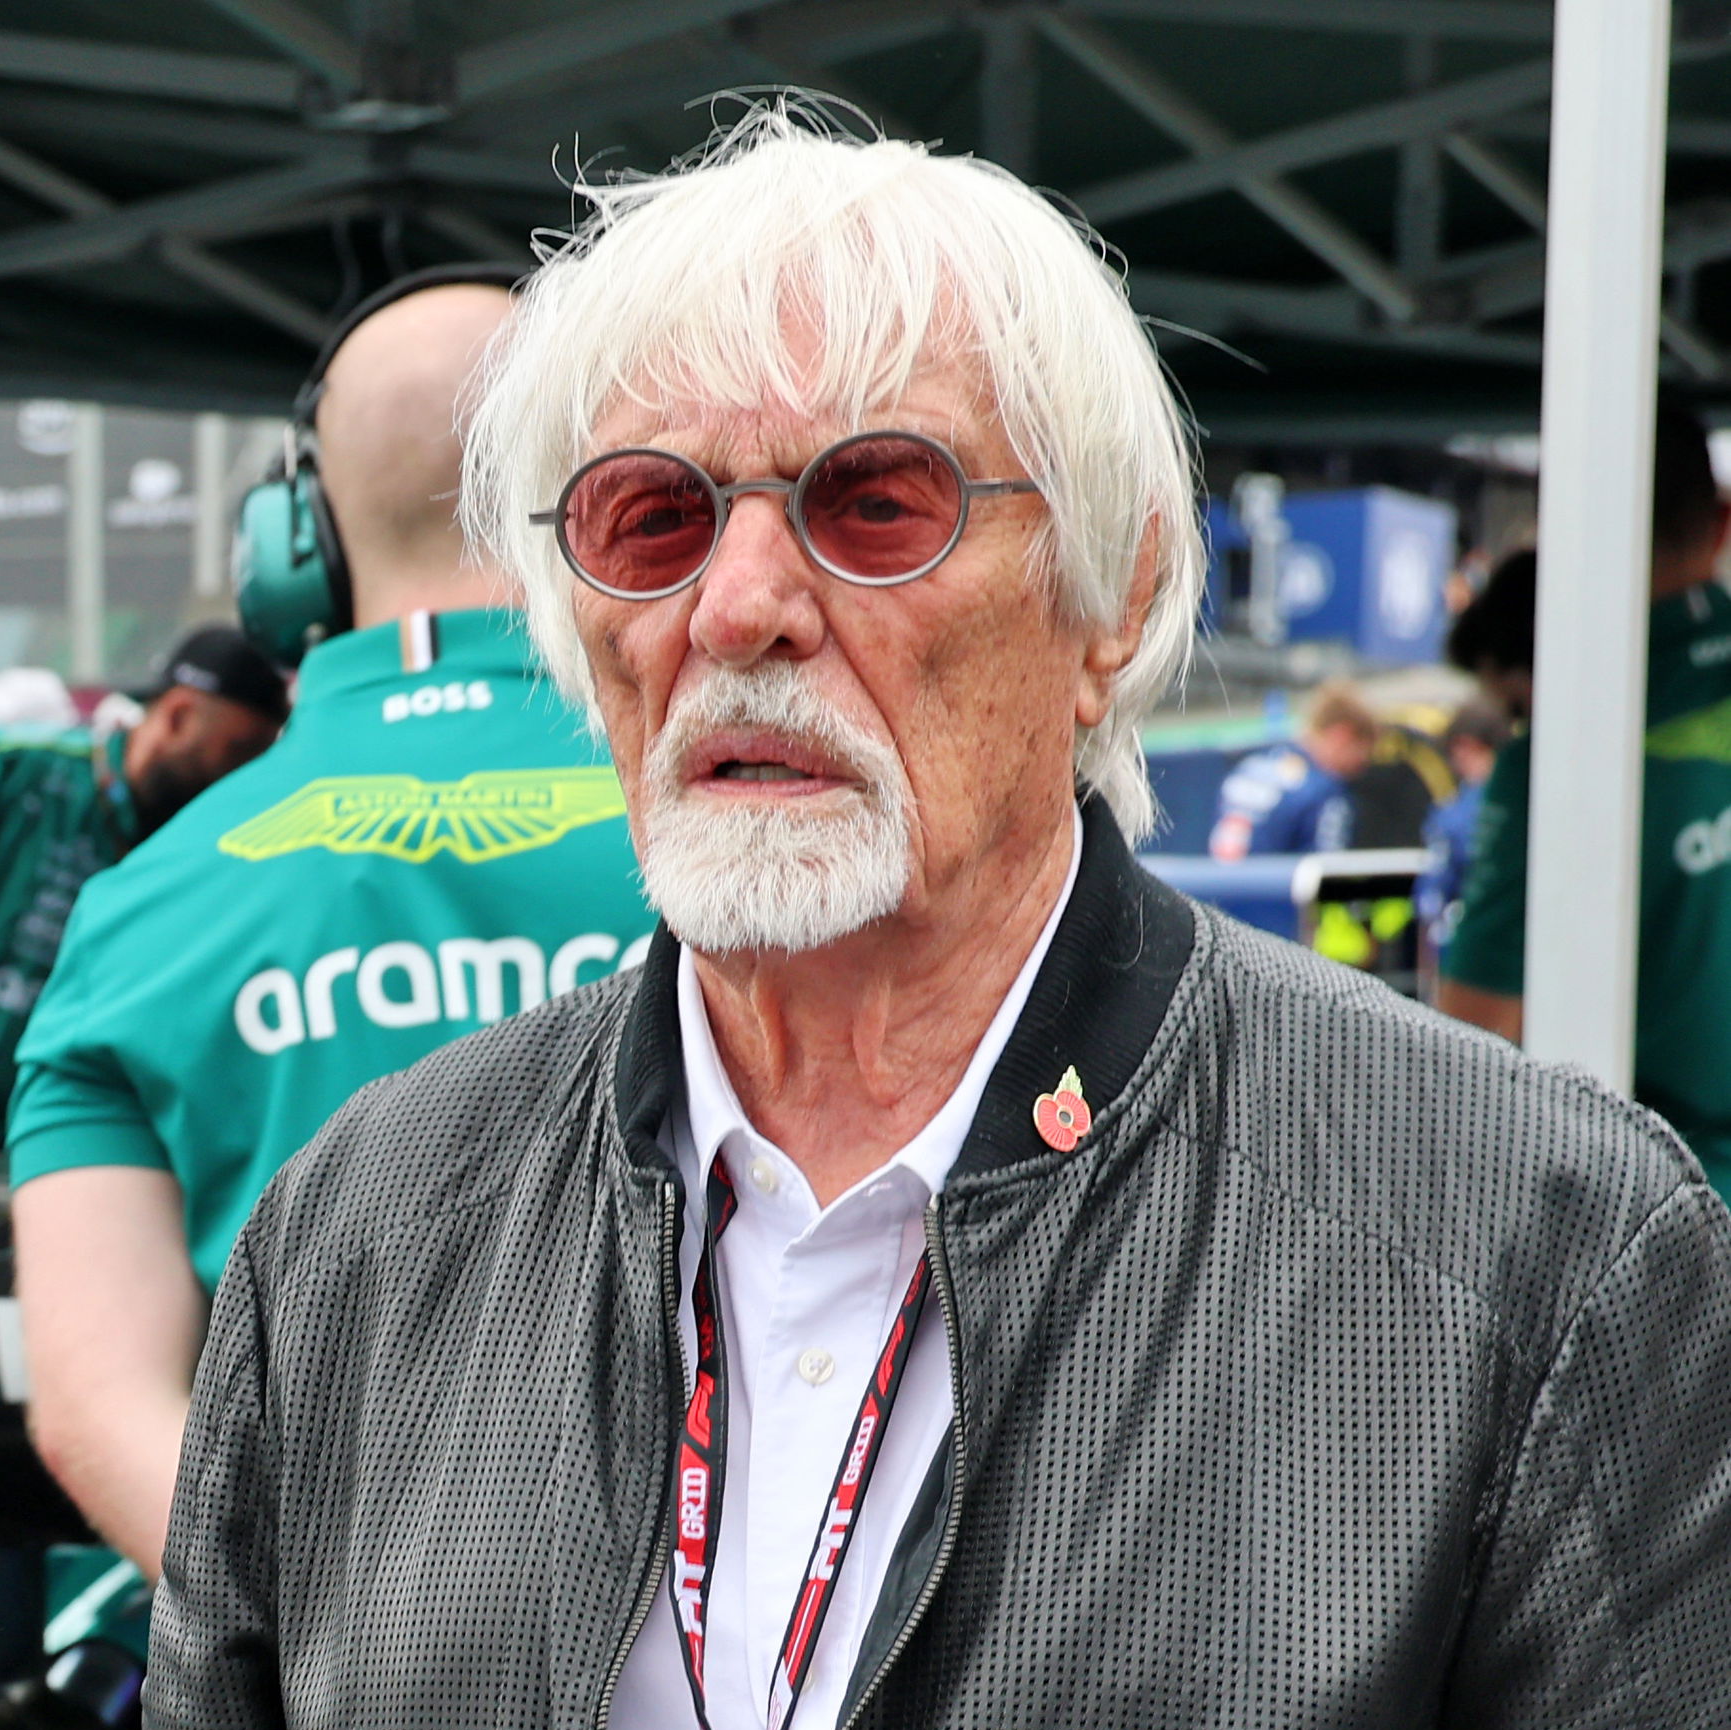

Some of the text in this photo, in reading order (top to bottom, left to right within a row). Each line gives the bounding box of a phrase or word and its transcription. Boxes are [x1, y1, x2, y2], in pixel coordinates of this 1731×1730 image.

[382, 680, 494, 724] BOSS
[842, 1415, 876, 1487] GRID
[680, 1466, 708, 1540] GRID
